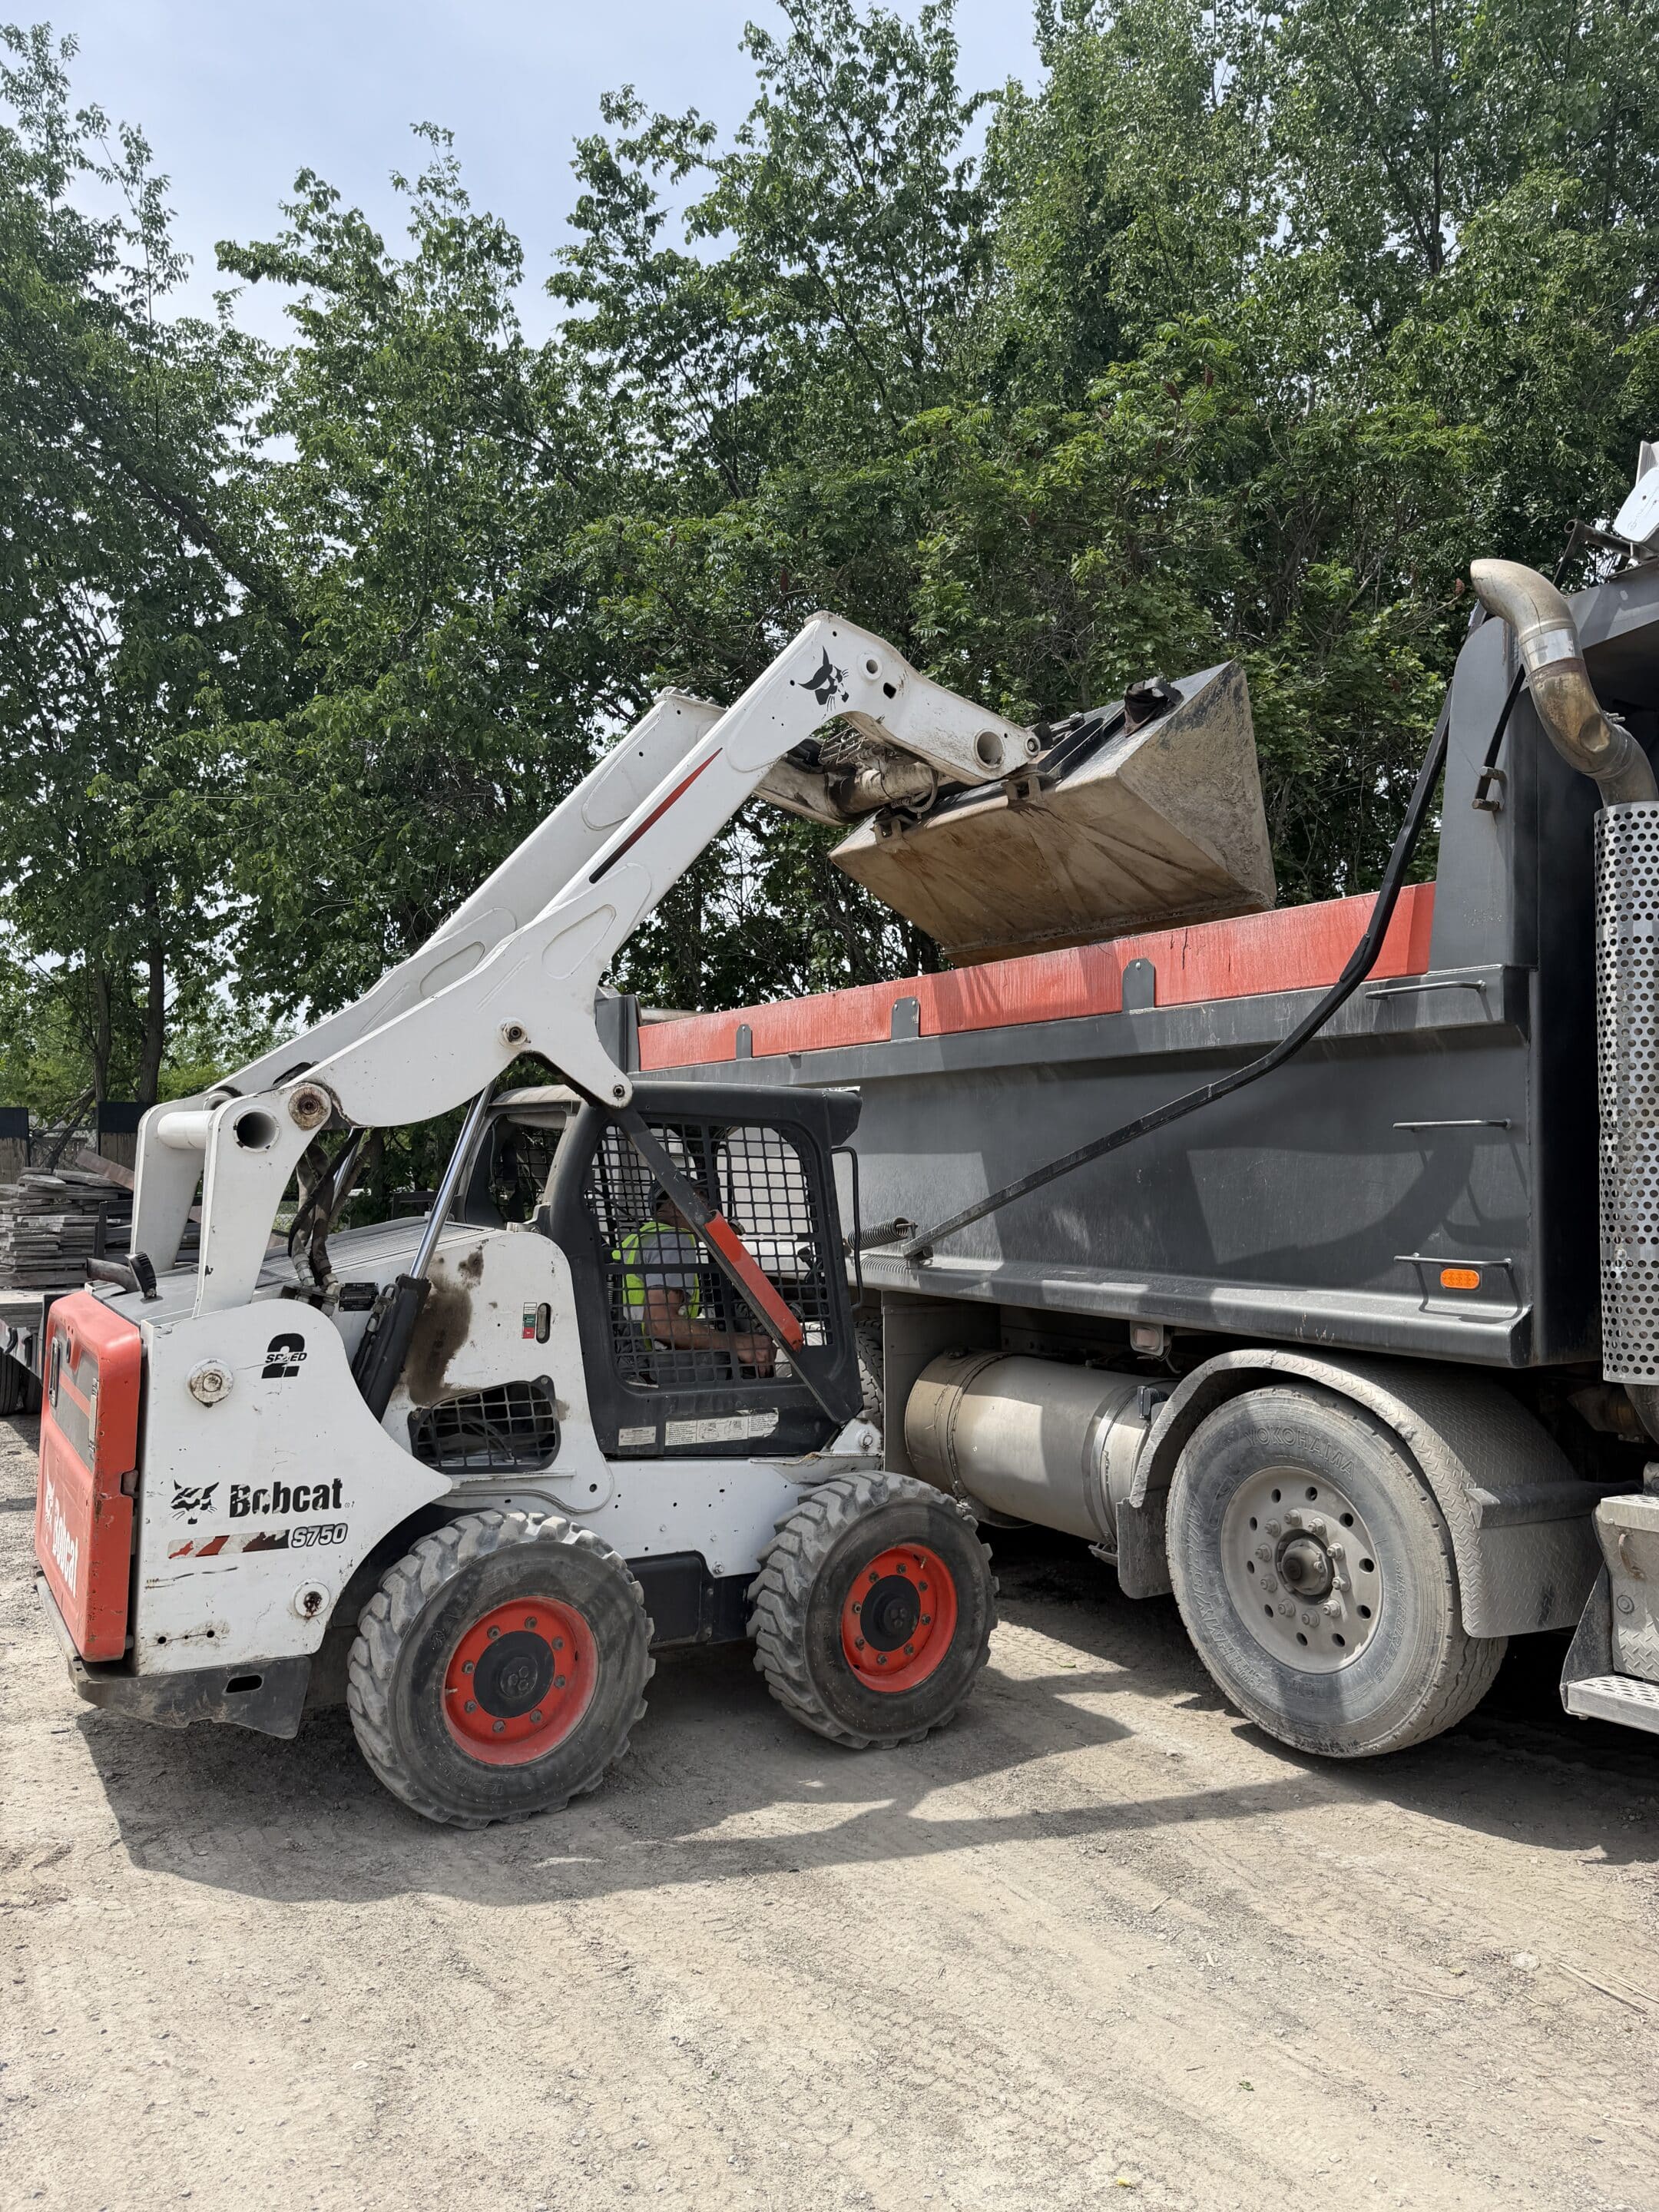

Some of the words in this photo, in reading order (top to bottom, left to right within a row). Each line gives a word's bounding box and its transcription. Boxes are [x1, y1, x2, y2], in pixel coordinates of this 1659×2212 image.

[261, 1333, 305, 1379] 2
[1243, 1426, 1355, 1482] YOKOHAMA
[229, 1478, 343, 1518] Bobcat
[291, 1522, 349, 1548] S750
